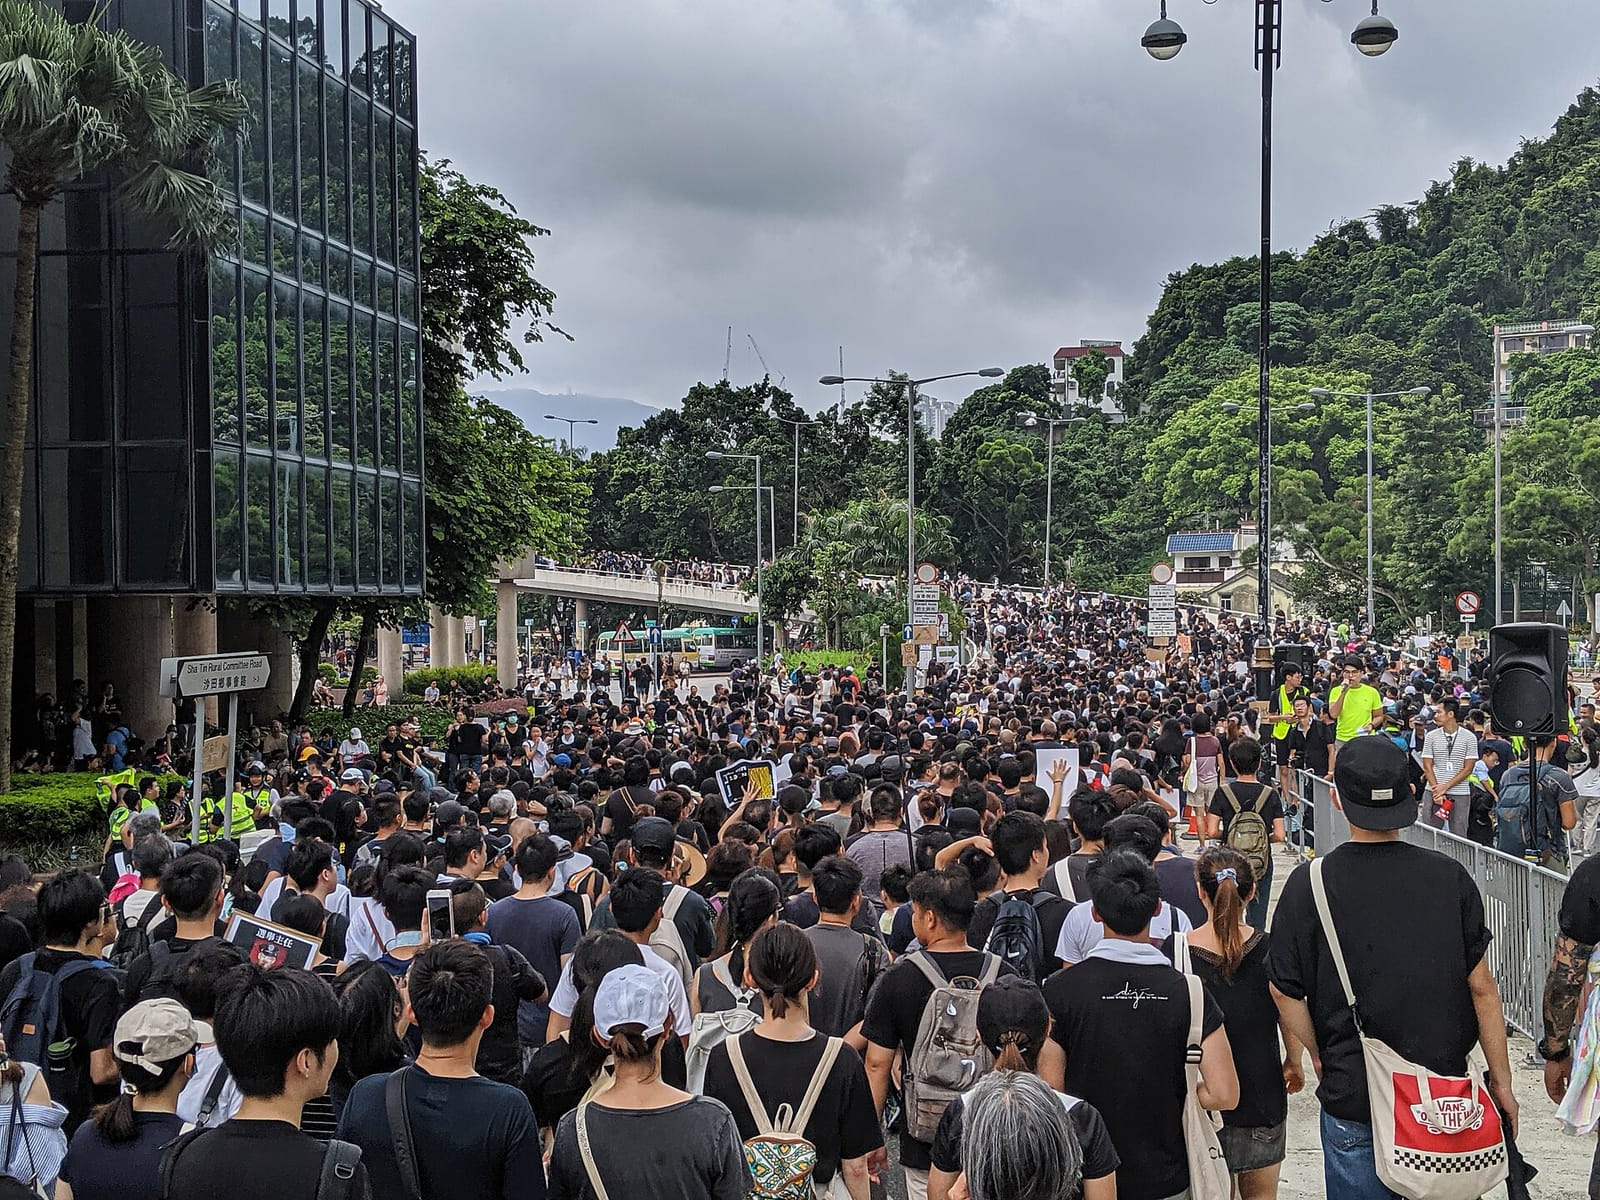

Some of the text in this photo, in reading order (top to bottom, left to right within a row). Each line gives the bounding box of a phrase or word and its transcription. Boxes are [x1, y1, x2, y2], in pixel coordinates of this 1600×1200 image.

[187, 659, 263, 674] Sha Tin Rural Committee Road
[1436, 1098, 1467, 1113] VANS
[1440, 1112, 1462, 1128] THE
